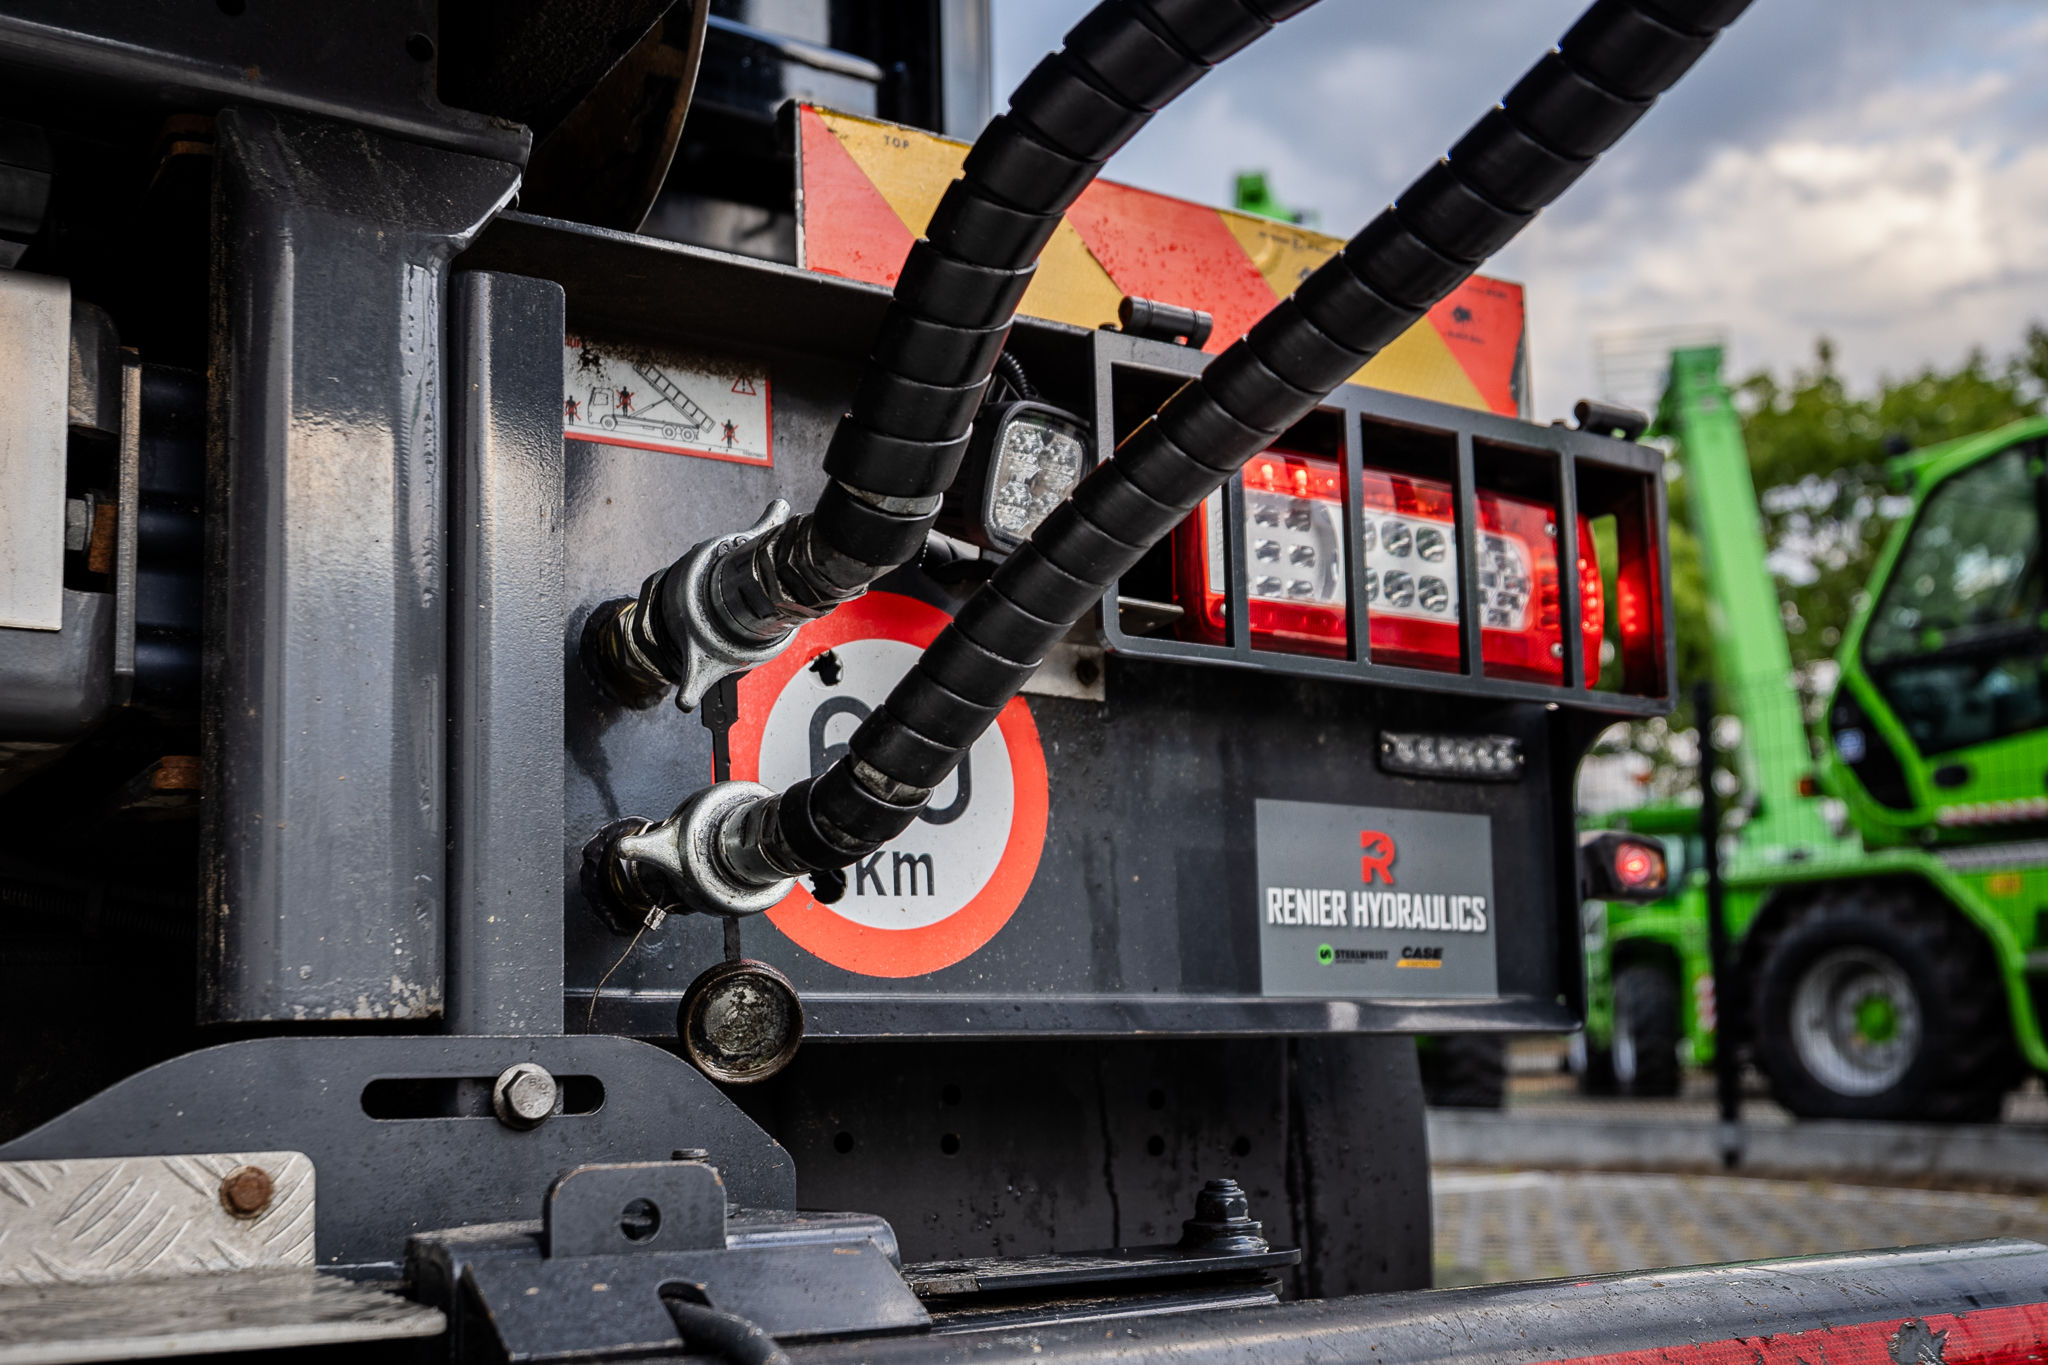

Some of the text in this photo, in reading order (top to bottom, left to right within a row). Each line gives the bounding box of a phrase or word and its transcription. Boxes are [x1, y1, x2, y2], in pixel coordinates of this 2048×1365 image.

[884, 134, 909, 149] TOP
[1267, 888, 1487, 931] RENIER HYDRAULICS
[1401, 946, 1443, 960] CASE
